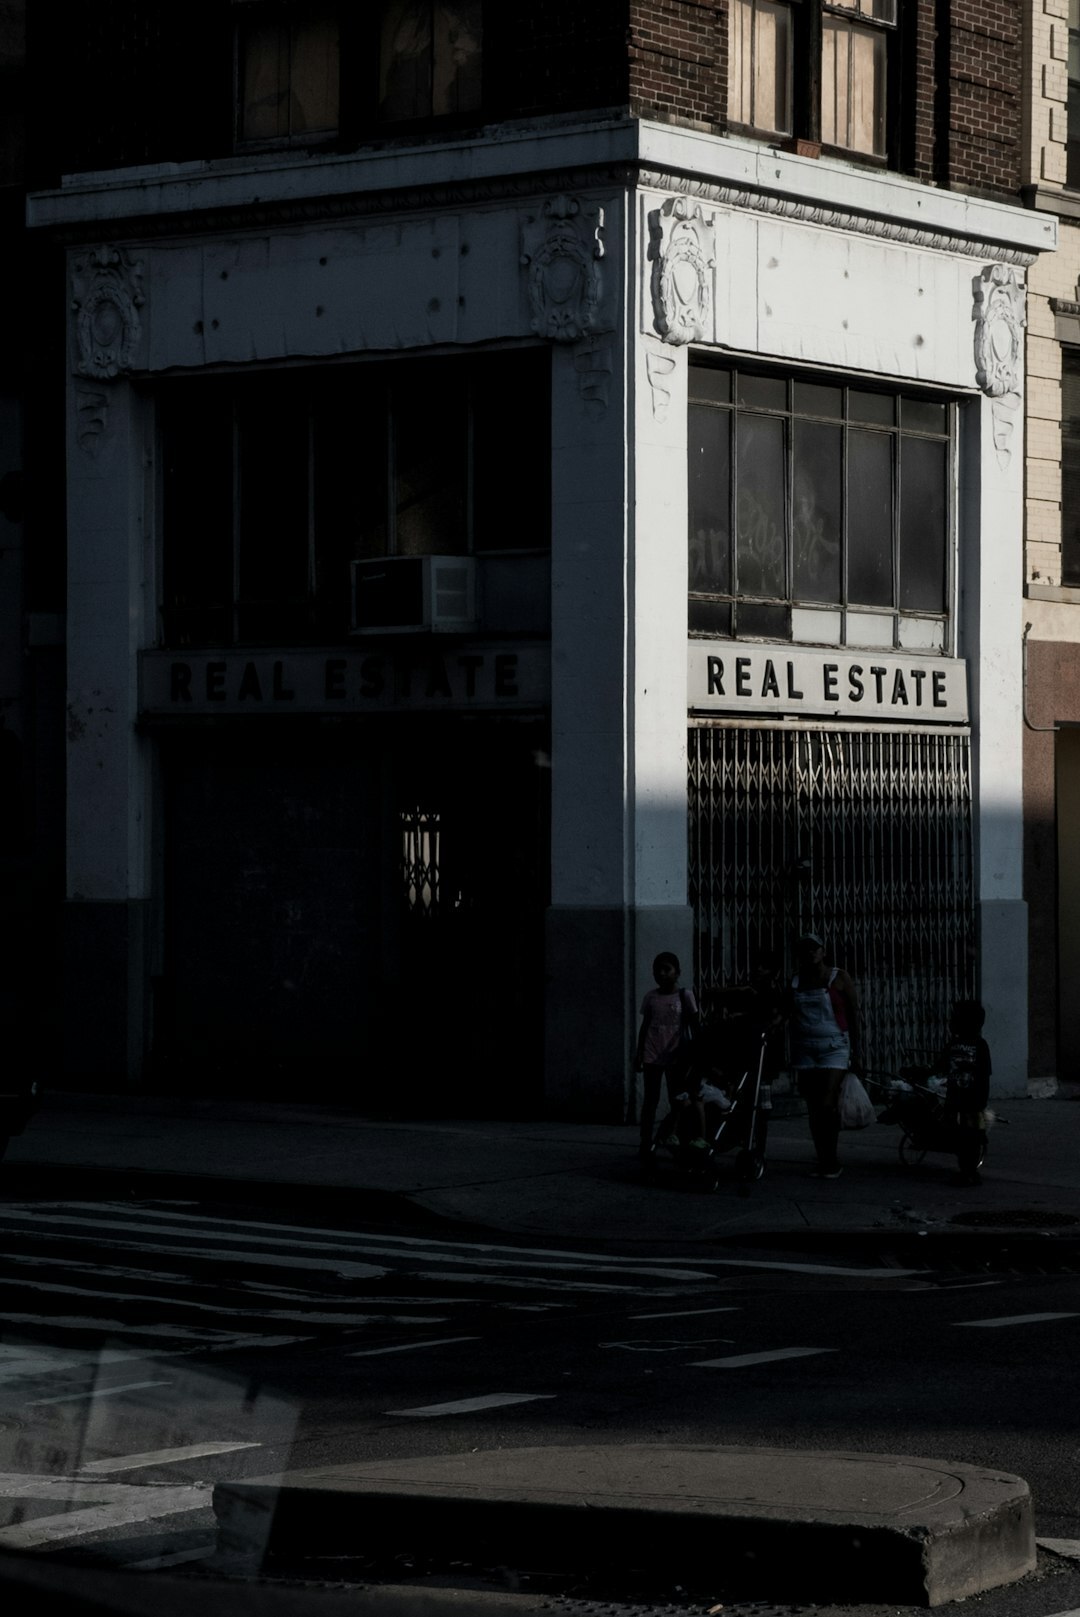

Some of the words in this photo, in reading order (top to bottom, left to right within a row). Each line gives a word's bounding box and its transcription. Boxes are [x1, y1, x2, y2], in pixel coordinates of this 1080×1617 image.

[171, 662, 294, 701] REAL
[326, 655, 518, 698] ESTATE
[707, 655, 803, 699] REAL
[823, 663, 947, 707] ESTATE
